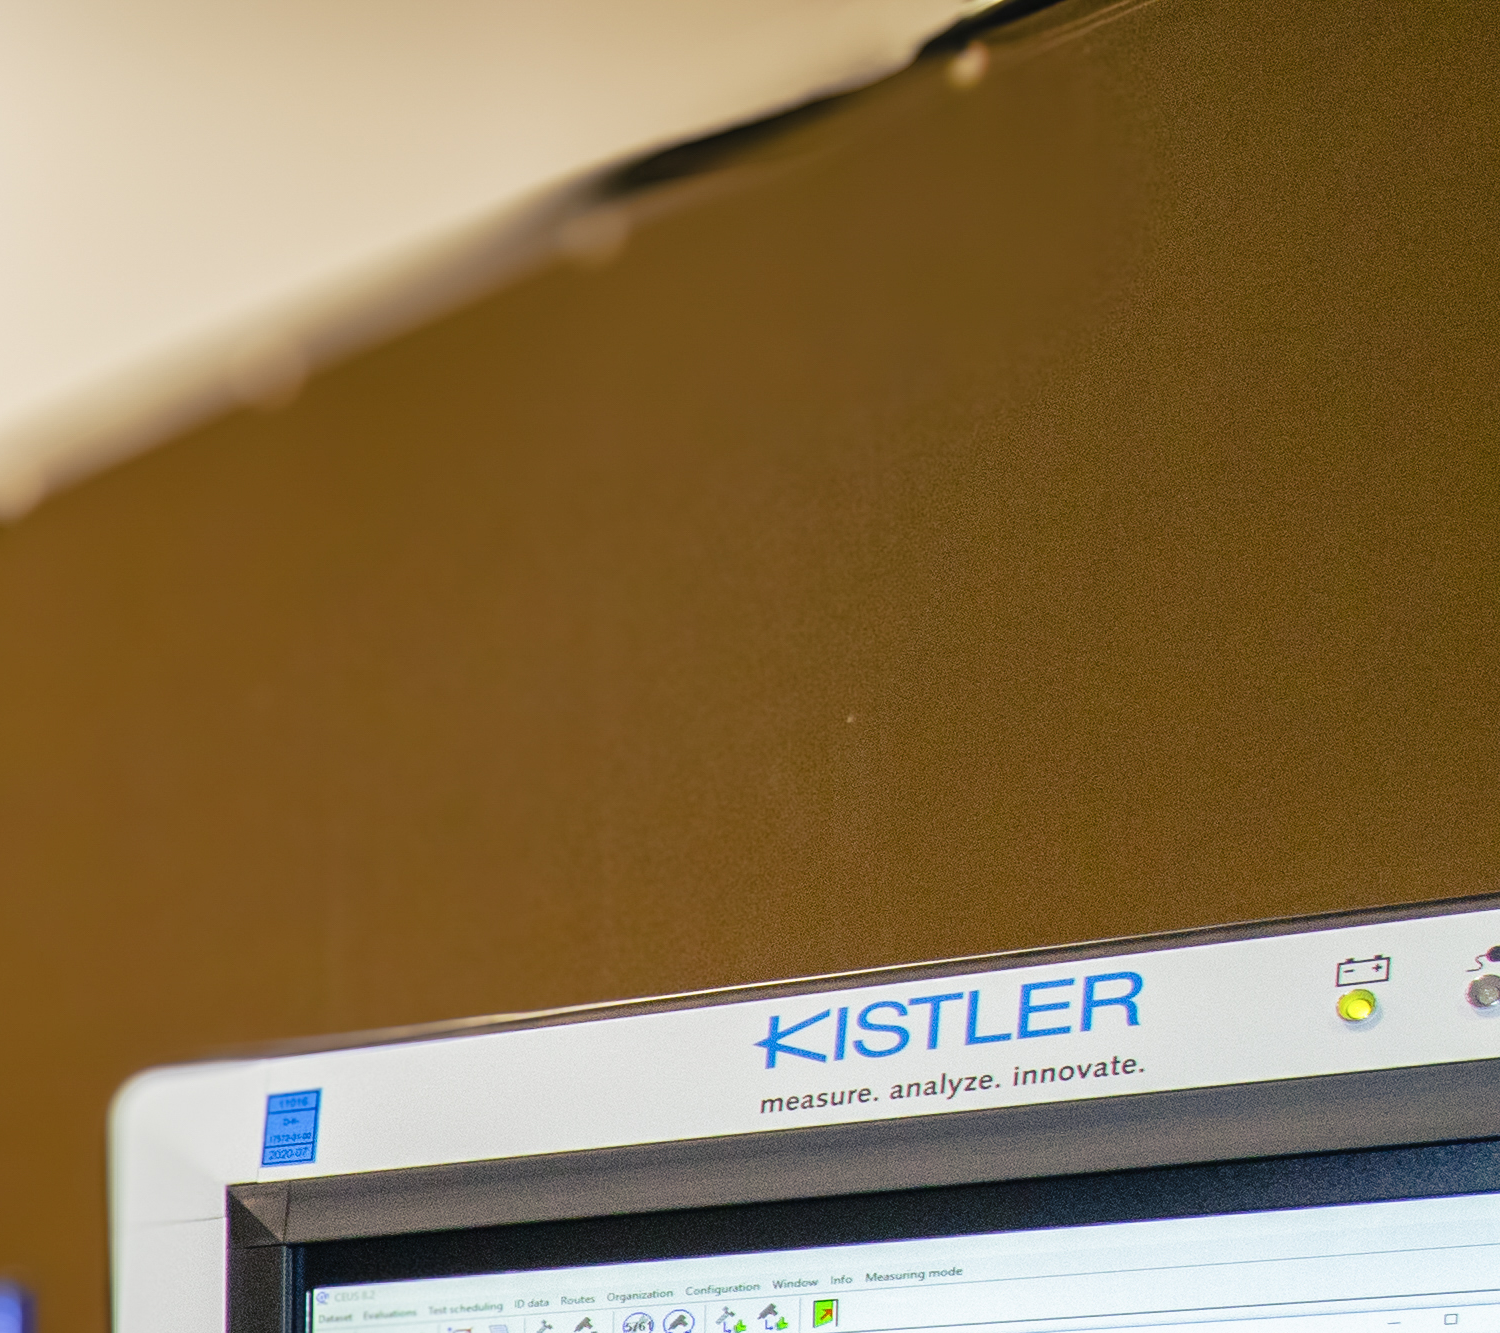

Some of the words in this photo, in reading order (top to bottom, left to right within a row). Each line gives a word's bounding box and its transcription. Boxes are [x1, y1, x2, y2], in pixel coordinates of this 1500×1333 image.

[753, 970, 1144, 1069] KISTLER
[759, 1086, 880, 1114] measure.
[889, 1071, 1001, 1100] analyze.
[1012, 1055, 1145, 1086] innovate.
[830, 1274, 853, 1286] Info
[865, 1268, 926, 1284] Measuring
[928, 1266, 963, 1279] mode
[685, 1281, 761, 1298] Configuration
[772, 1277, 818, 1290] Window
[560, 1295, 595, 1306] Routes
[607, 1288, 674, 1304] Organization
[429, 1305, 450, 1316] Test
[451, 1301, 504, 1316] scheduling
[514, 1298, 526, 1309] ID
[527, 1298, 550, 1308] data
[318, 1314, 353, 1324] Dataset
[363, 1309, 417, 1321] Evaluations
